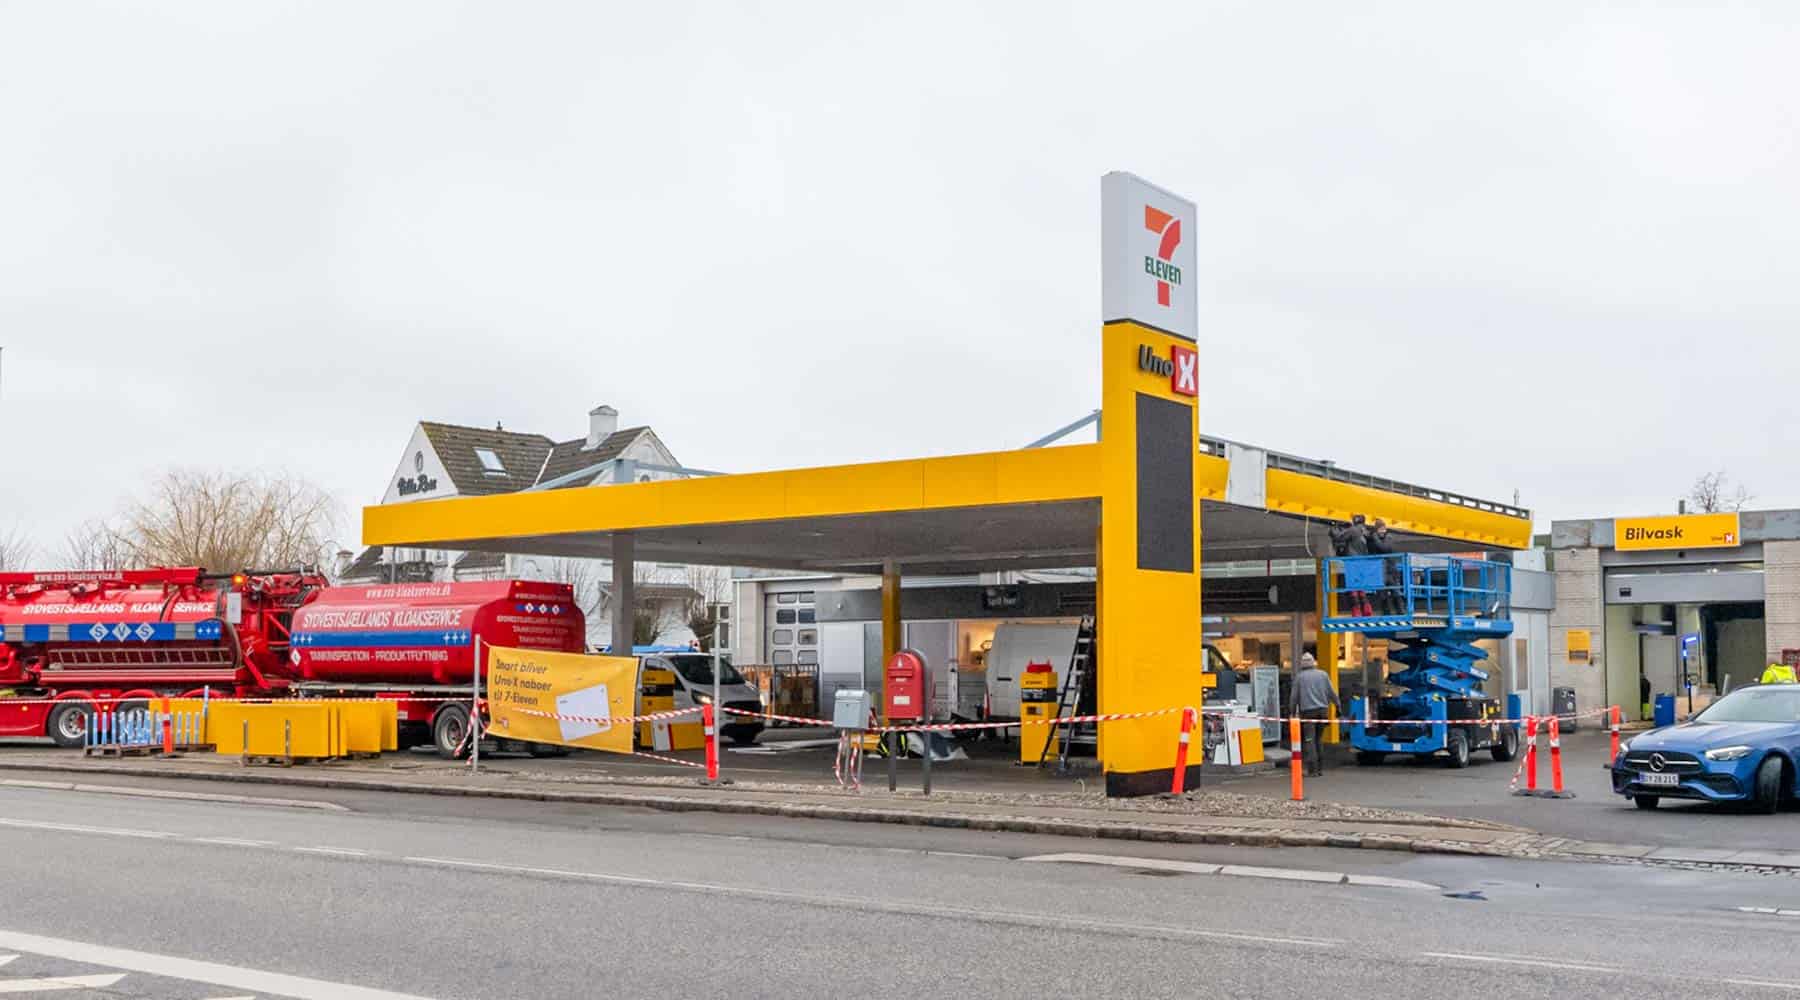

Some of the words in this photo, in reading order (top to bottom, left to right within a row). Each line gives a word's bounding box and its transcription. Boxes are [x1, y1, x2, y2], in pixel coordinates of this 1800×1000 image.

[1144, 204, 1182, 307] 7
[1137, 343, 1175, 378] Uno
[1625, 526, 1683, 541] Bilvask
[172, 602, 214, 613] SERVICE
[392, 608, 463, 628] KLOAKSERVICE
[93, 624, 105, 637] S
[117, 624, 127, 637] V
[139, 624, 151, 637] S
[520, 662, 548, 675] bliver
[520, 679, 553, 692] naboer
